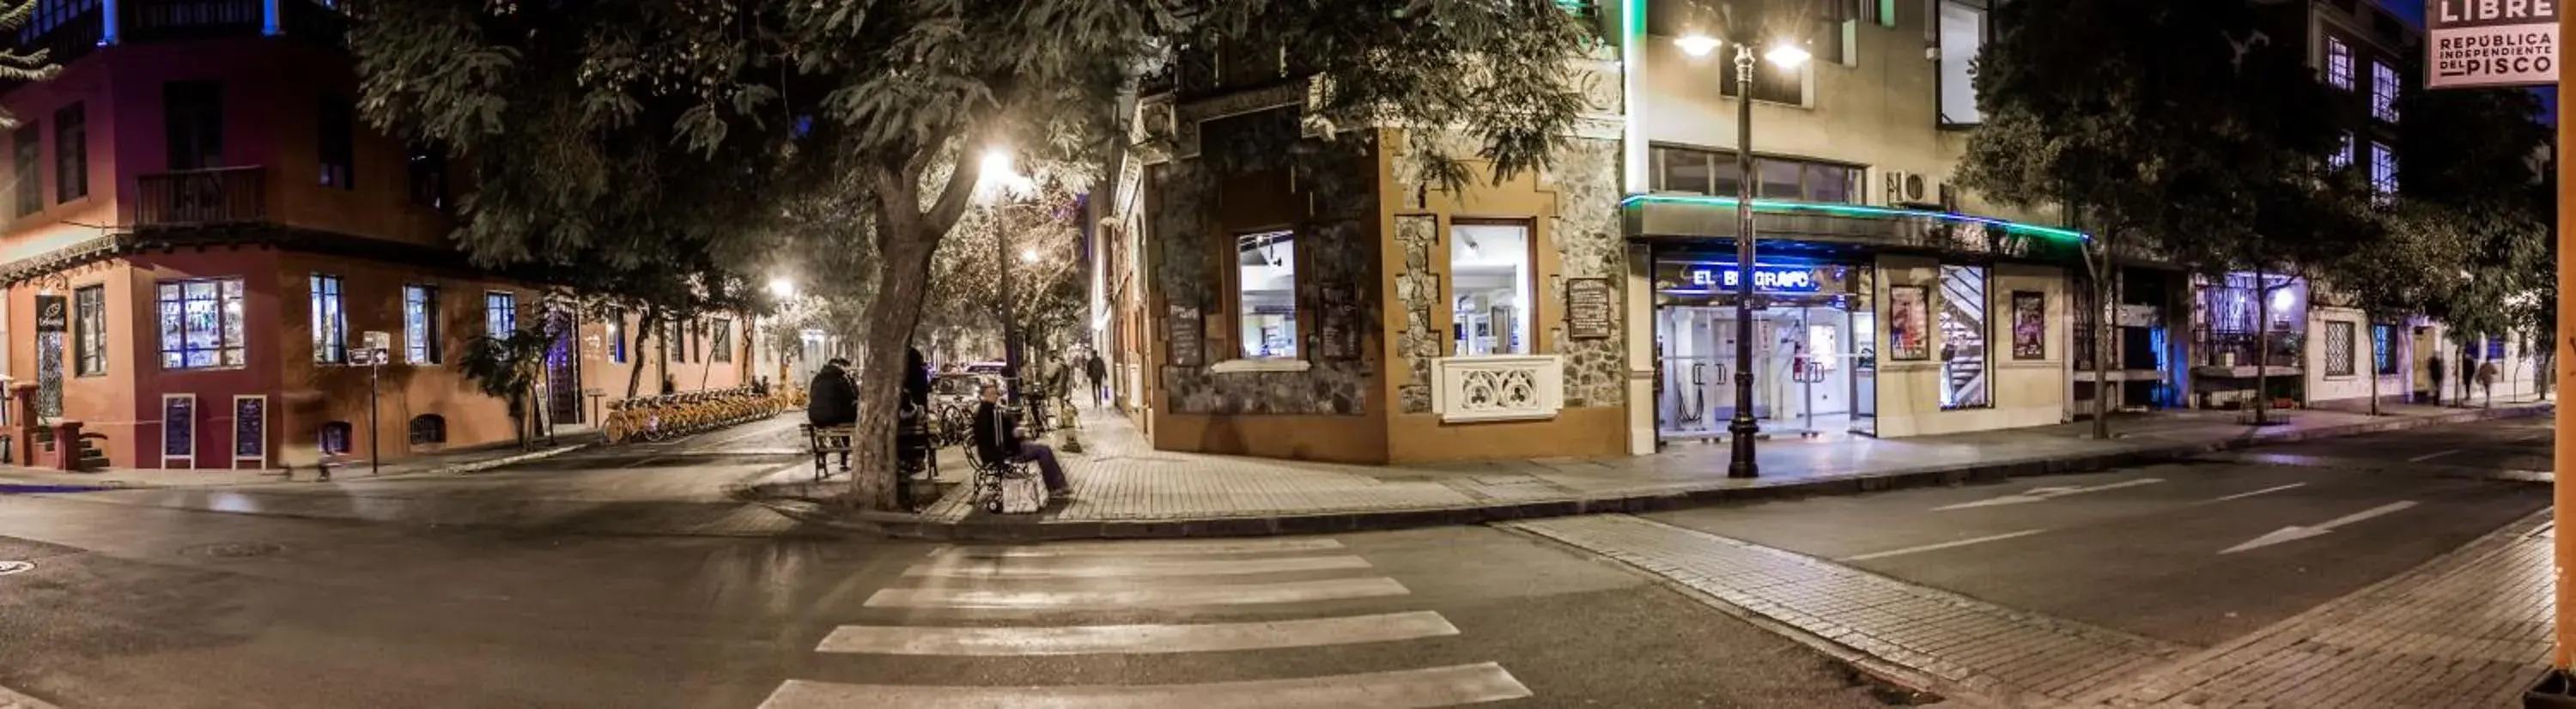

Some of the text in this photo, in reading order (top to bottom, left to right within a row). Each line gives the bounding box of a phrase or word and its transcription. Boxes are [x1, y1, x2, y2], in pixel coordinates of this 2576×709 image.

[2440, 0, 2553, 22] LIBRE
[2439, 33, 2551, 51] REPÚBLICA
[2439, 45, 2552, 59] INDEPENDIENTE
[2439, 56, 2551, 76] DEL PISCO
[1693, 270, 1716, 285] EL
